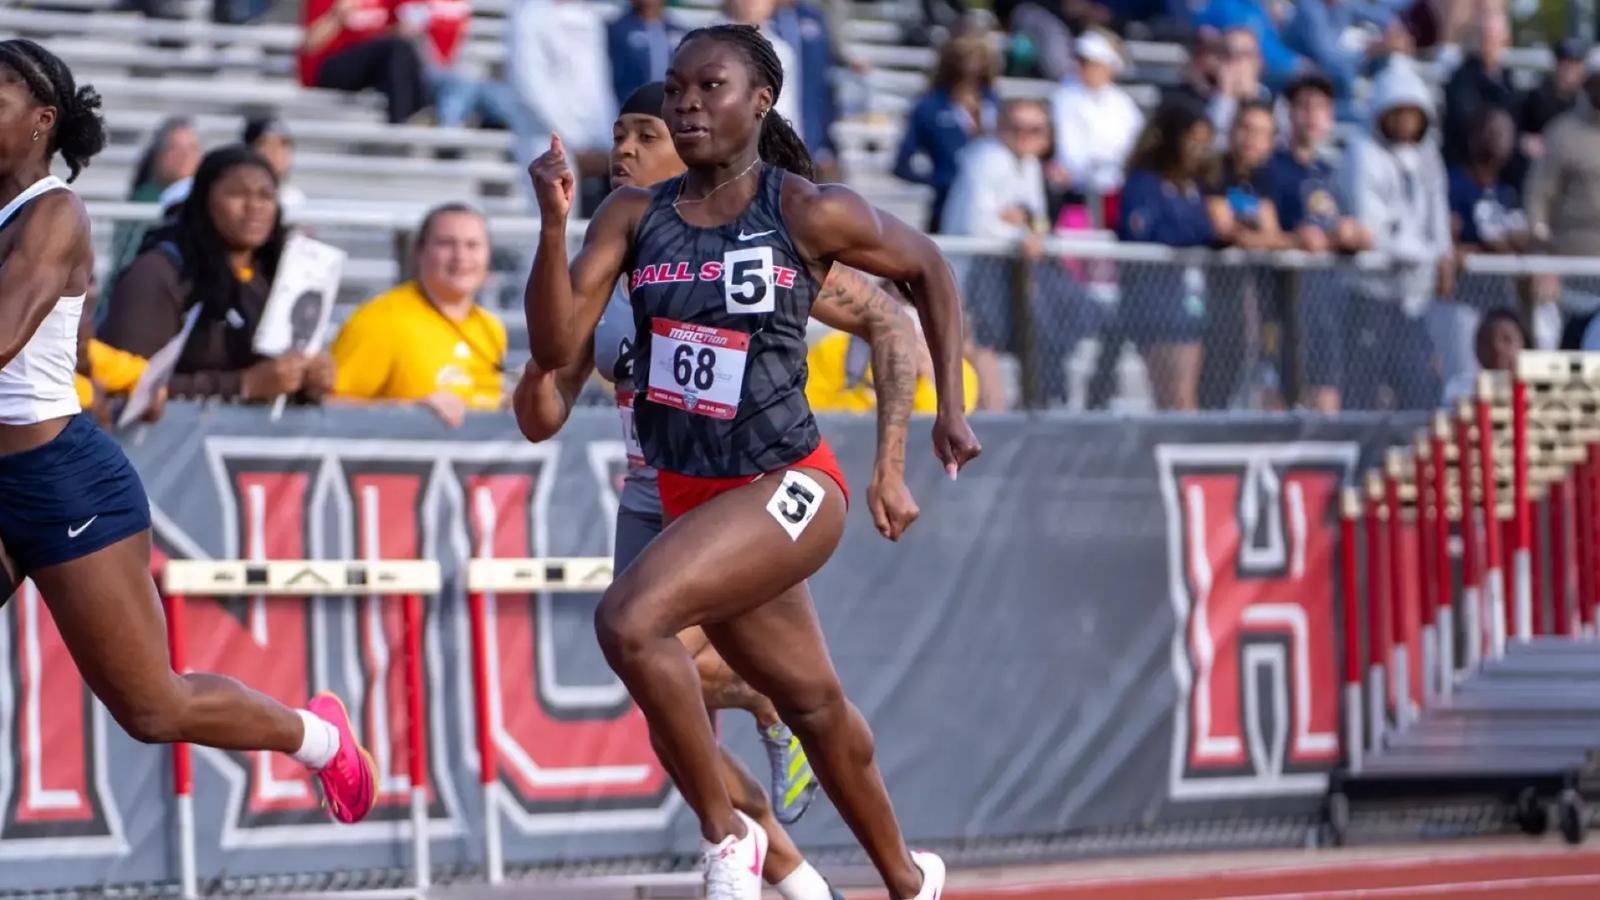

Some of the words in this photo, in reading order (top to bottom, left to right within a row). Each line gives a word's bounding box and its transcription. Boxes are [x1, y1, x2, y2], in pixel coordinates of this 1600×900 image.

[631, 262, 695, 290] BALL
[730, 258, 768, 306] 5
[673, 343, 717, 391] 68
[777, 481, 815, 524] 5
